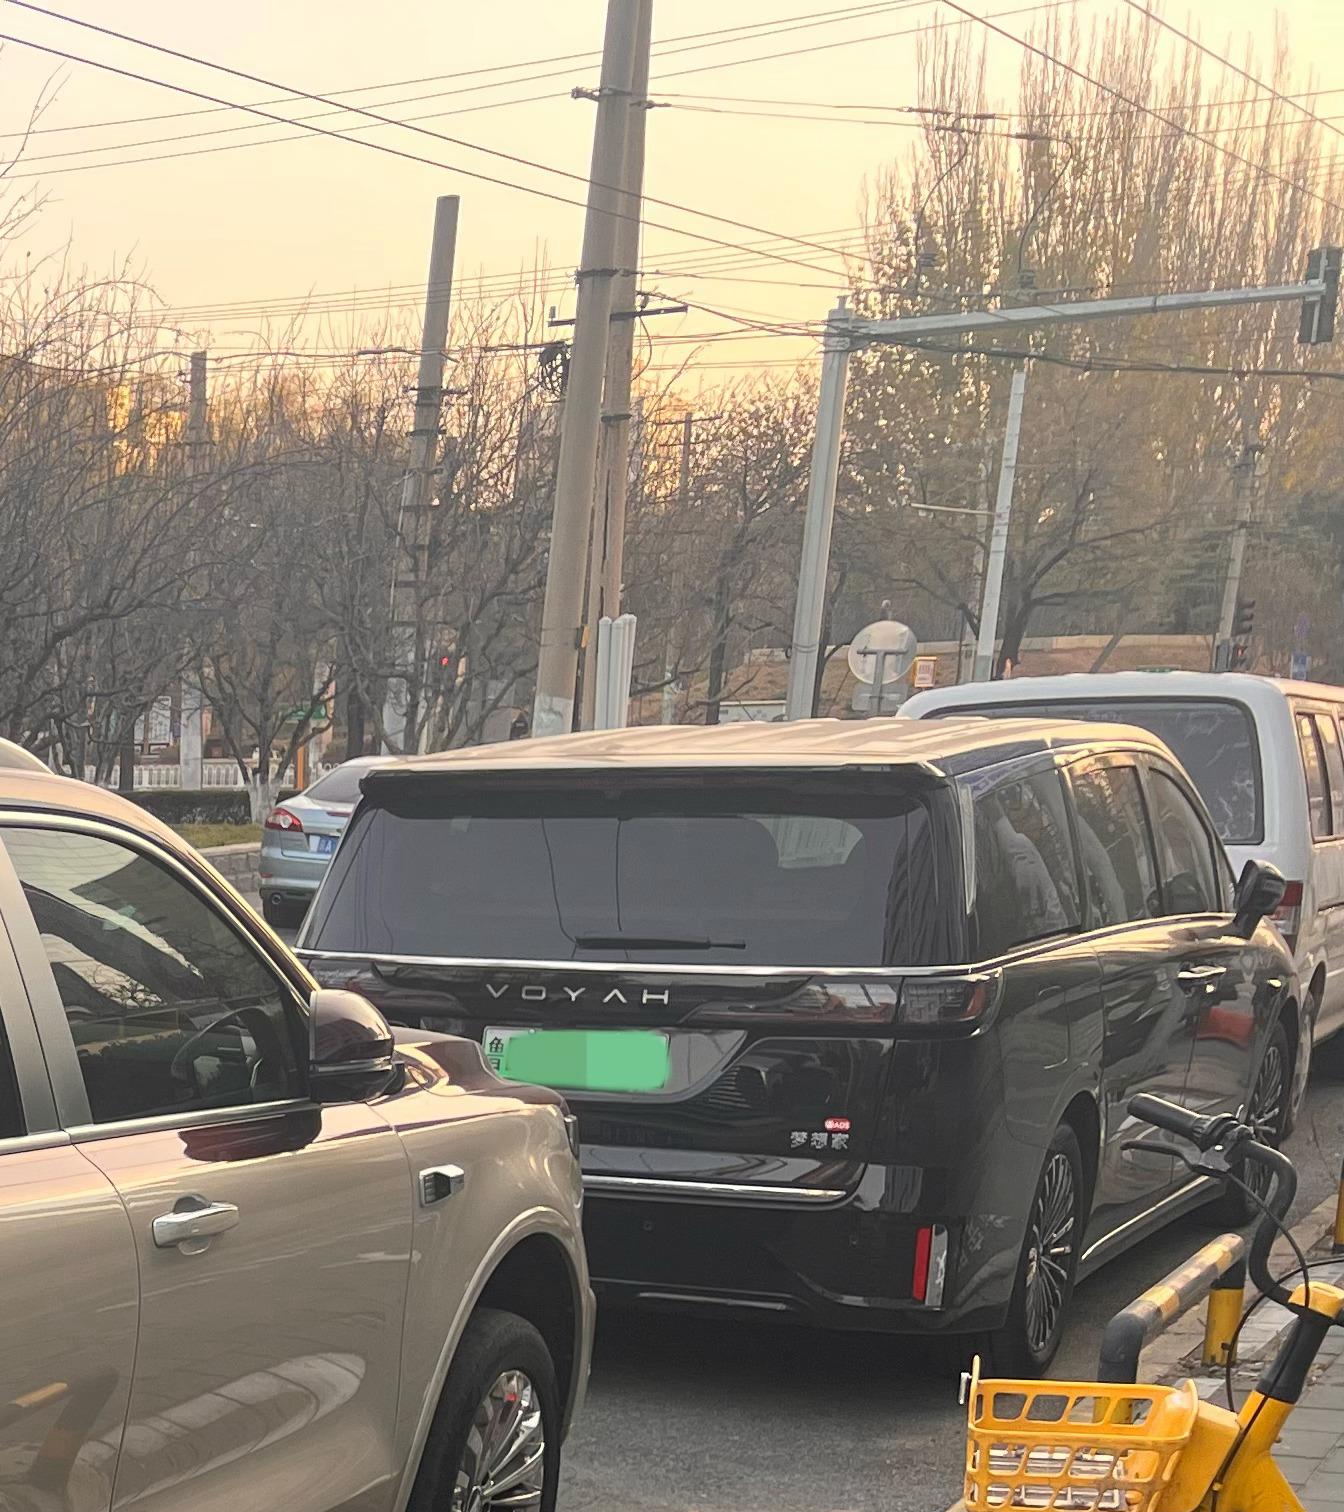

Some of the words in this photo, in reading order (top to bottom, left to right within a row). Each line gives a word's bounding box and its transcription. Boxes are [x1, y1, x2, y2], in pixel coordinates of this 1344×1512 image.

[486, 983, 669, 1005] VOYAH
[790, 1131, 849, 1150] 梦想家
